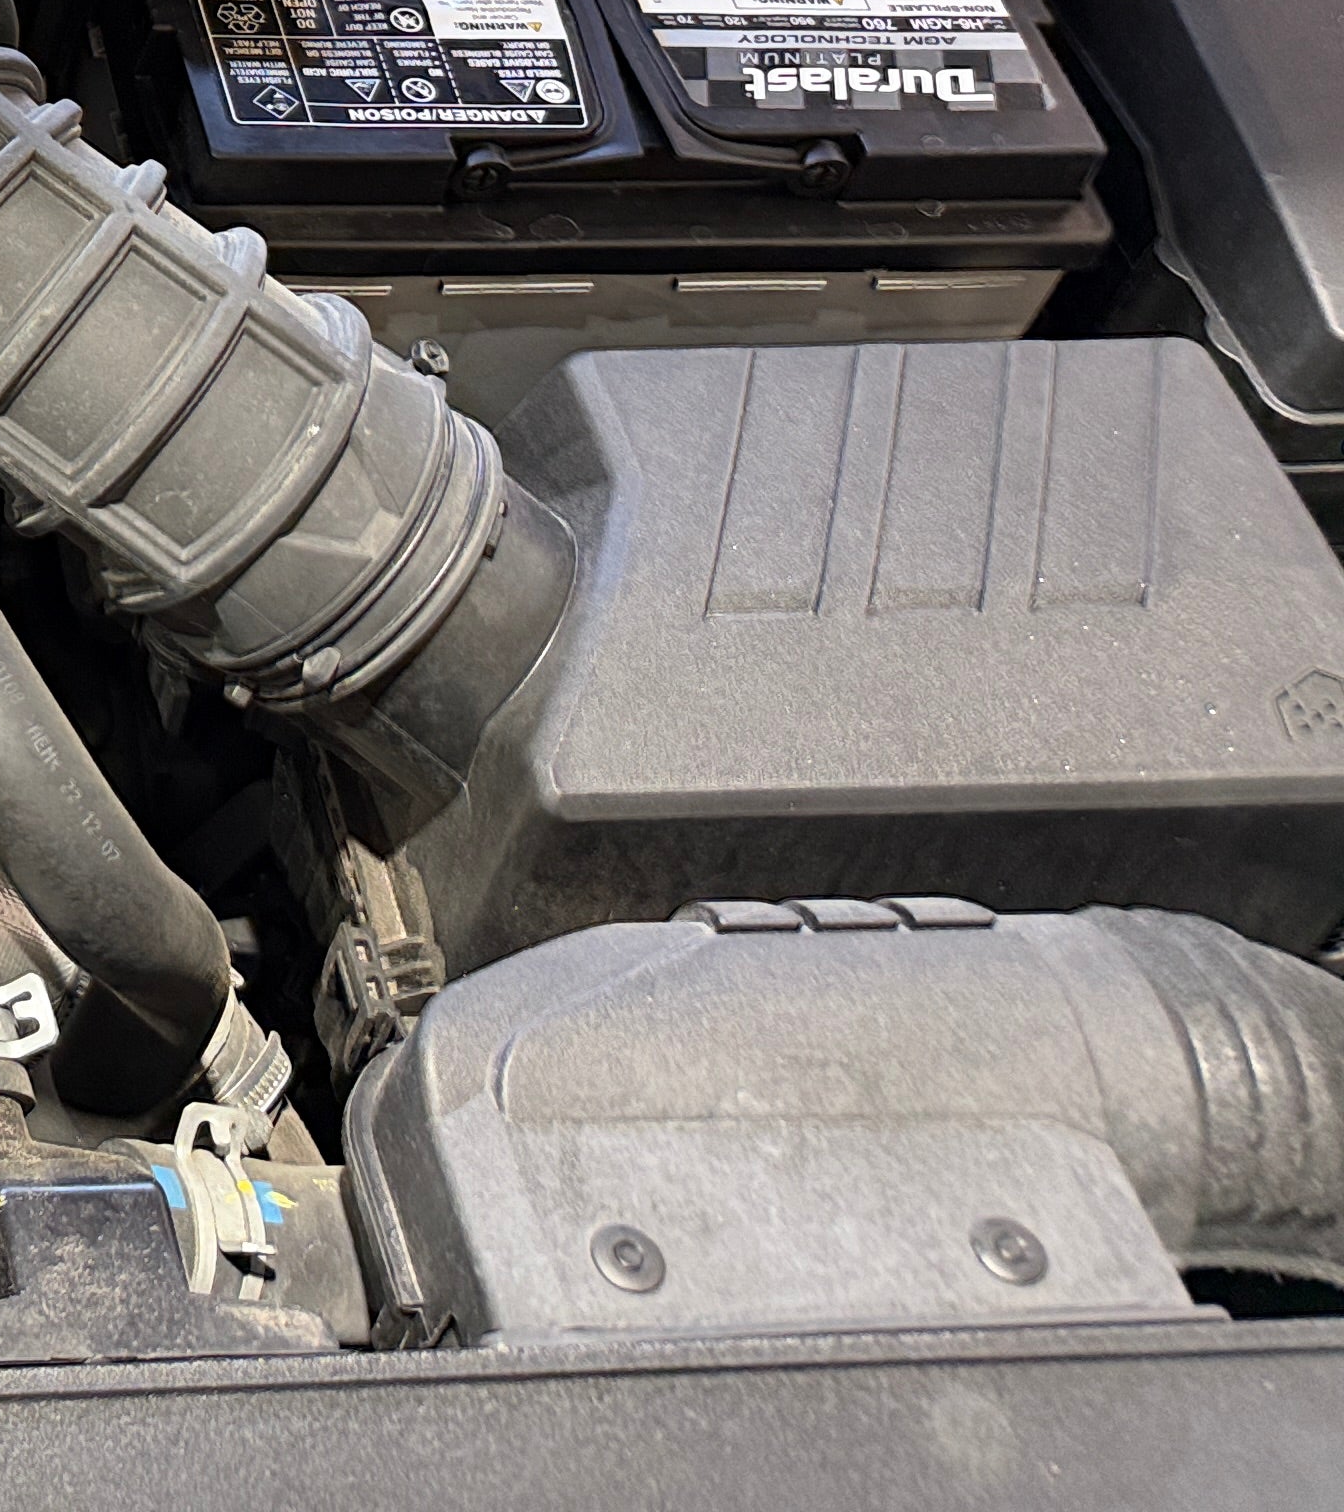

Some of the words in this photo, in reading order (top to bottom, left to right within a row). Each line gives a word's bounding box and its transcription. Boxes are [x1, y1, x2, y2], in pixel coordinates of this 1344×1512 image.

[289, 8, 316, 18] NOT
[888, 4, 996, 13] NON-SPILLABLE
[297, 19, 316, 28] DO
[676, 15, 694, 24] 70
[724, 16, 747, 25] 120
[861, 17, 898, 29] 760
[909, 18, 984, 29] H6-AGM
[344, 23, 363, 31] OUT
[365, 23, 388, 31] KEEP
[453, 21, 528, 31] WARNING:
[737, 34, 893, 45] TECHNOLOGY
[903, 36, 957, 46] AGM
[502, 58, 558, 67] EXPLOSIVE
[738, 51, 881, 65] PLATINUM
[302, 67, 326, 76] ACID
[328, 67, 378, 77] SULFURIC
[742, 67, 994, 102] Duralast
[348, 108, 528, 122] DANGER/POISON
